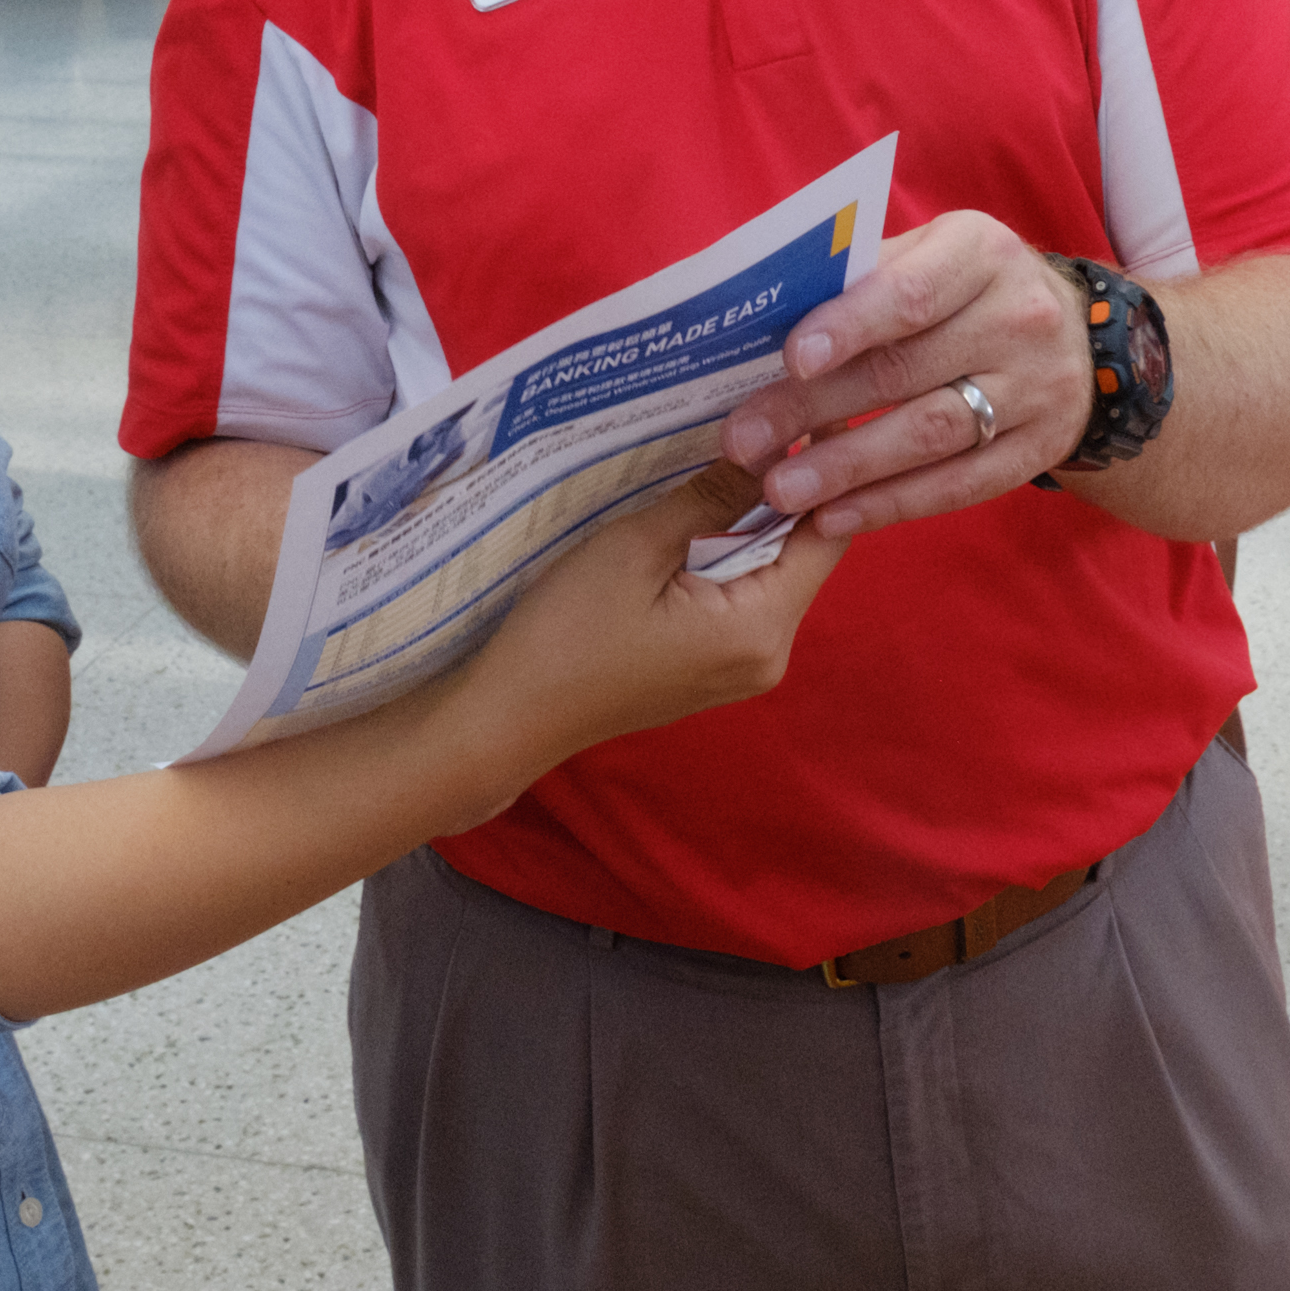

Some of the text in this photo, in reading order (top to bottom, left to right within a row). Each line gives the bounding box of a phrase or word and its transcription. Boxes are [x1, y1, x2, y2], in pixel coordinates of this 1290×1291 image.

[520, 348, 640, 405] BANKING
[644, 315, 719, 359] MADE
[722, 281, 783, 328] EASY
[702, 346, 741, 367] Writing
[741, 334, 772, 352] Guide
